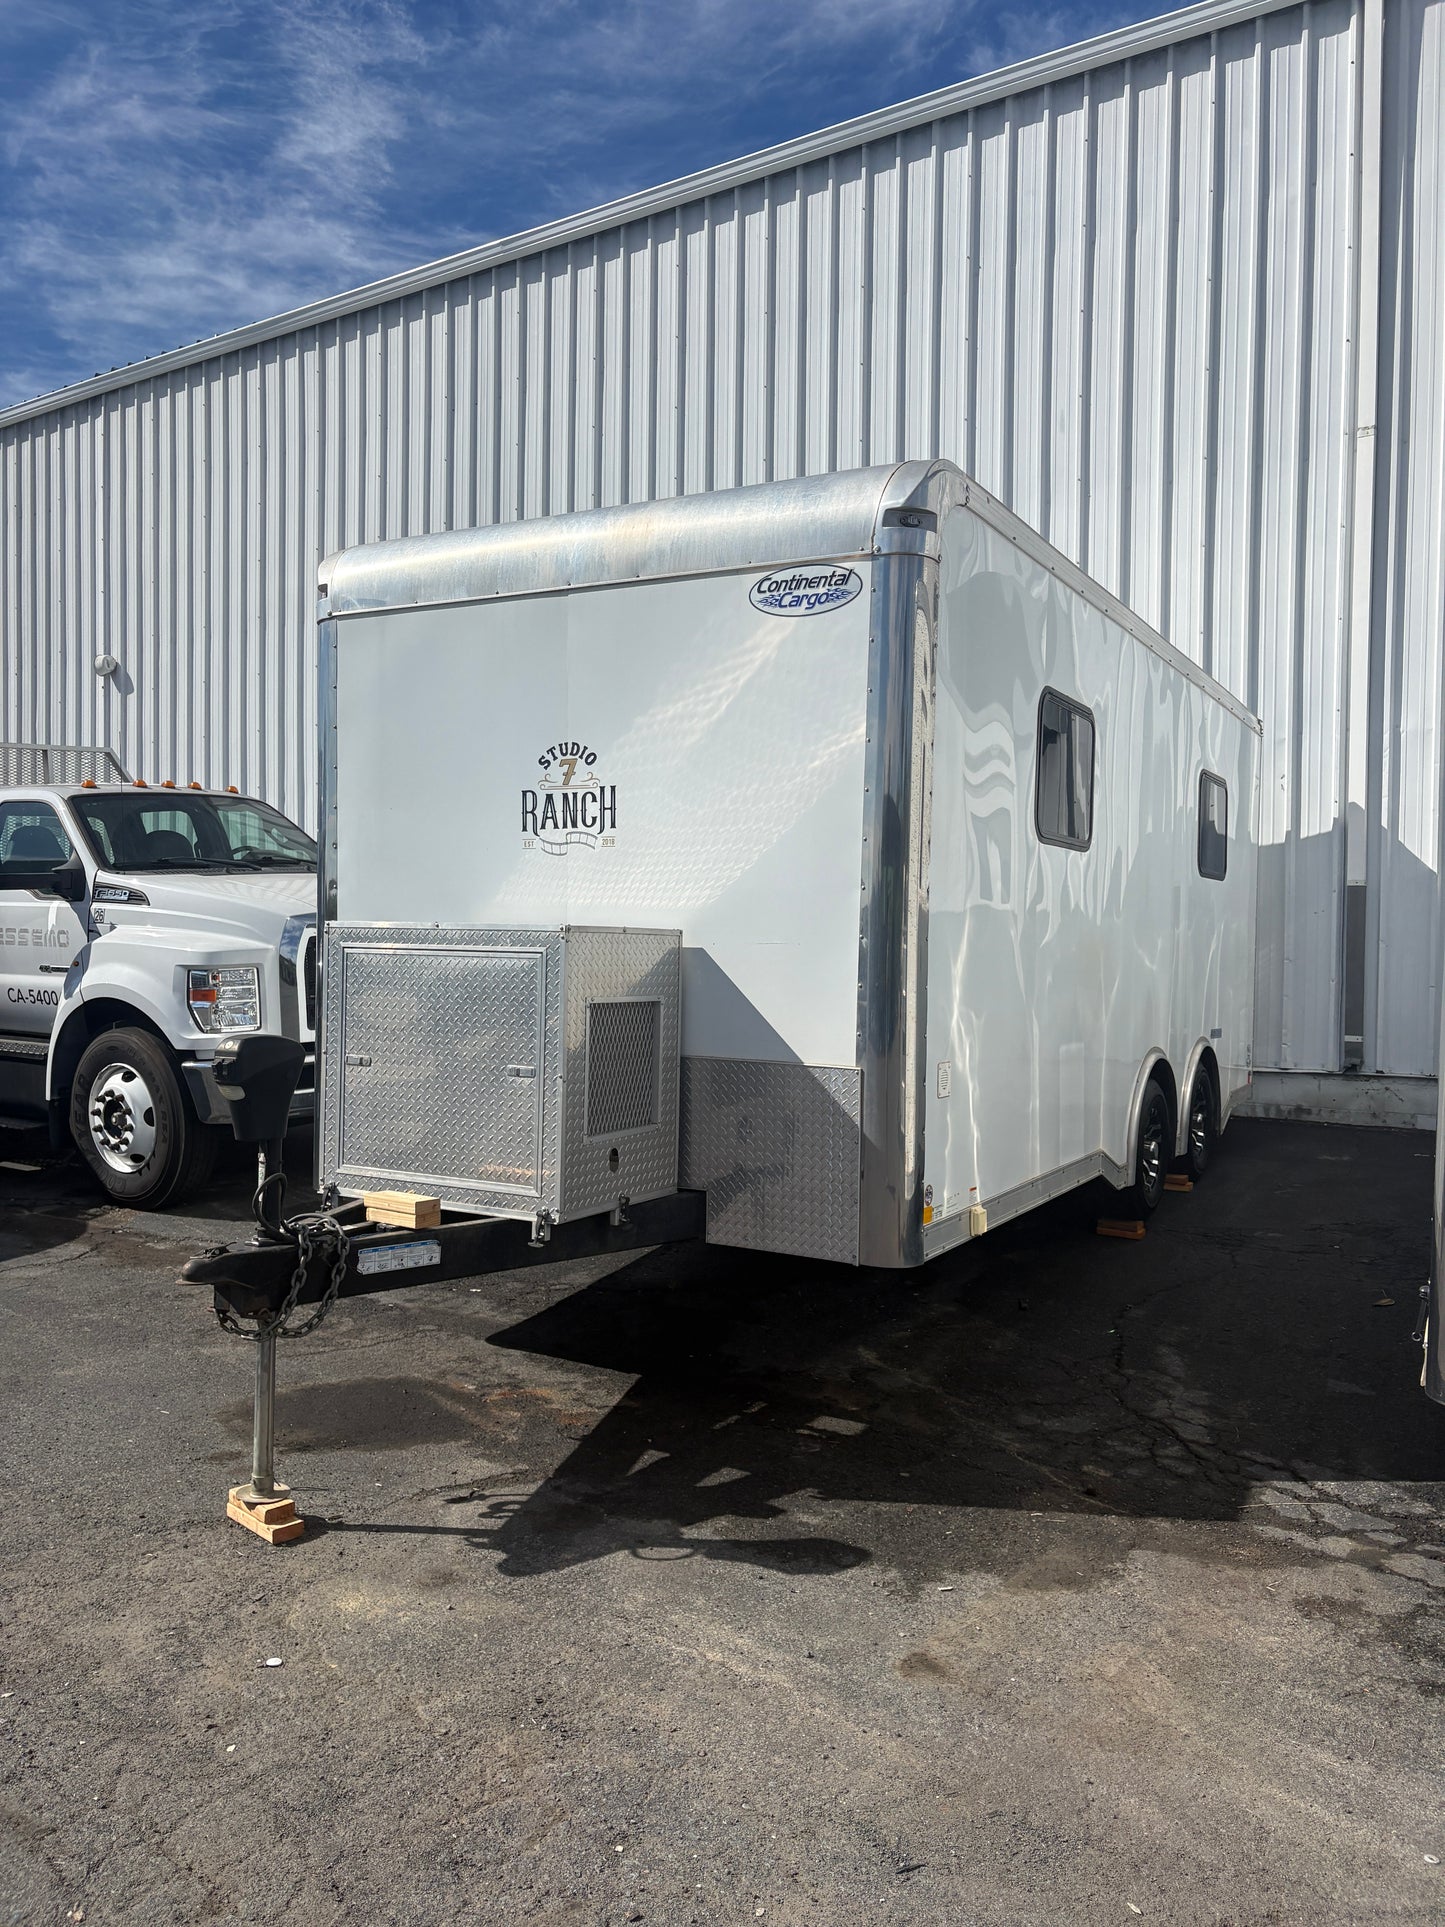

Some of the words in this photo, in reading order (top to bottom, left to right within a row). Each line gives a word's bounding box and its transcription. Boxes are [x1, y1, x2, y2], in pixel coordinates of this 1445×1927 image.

[757, 568, 854, 594] Continental
[778, 591, 831, 610] Cargo
[538, 741, 598, 770] STUDIO
[559, 757, 578, 785] 7
[521, 785, 617, 837] RANCH
